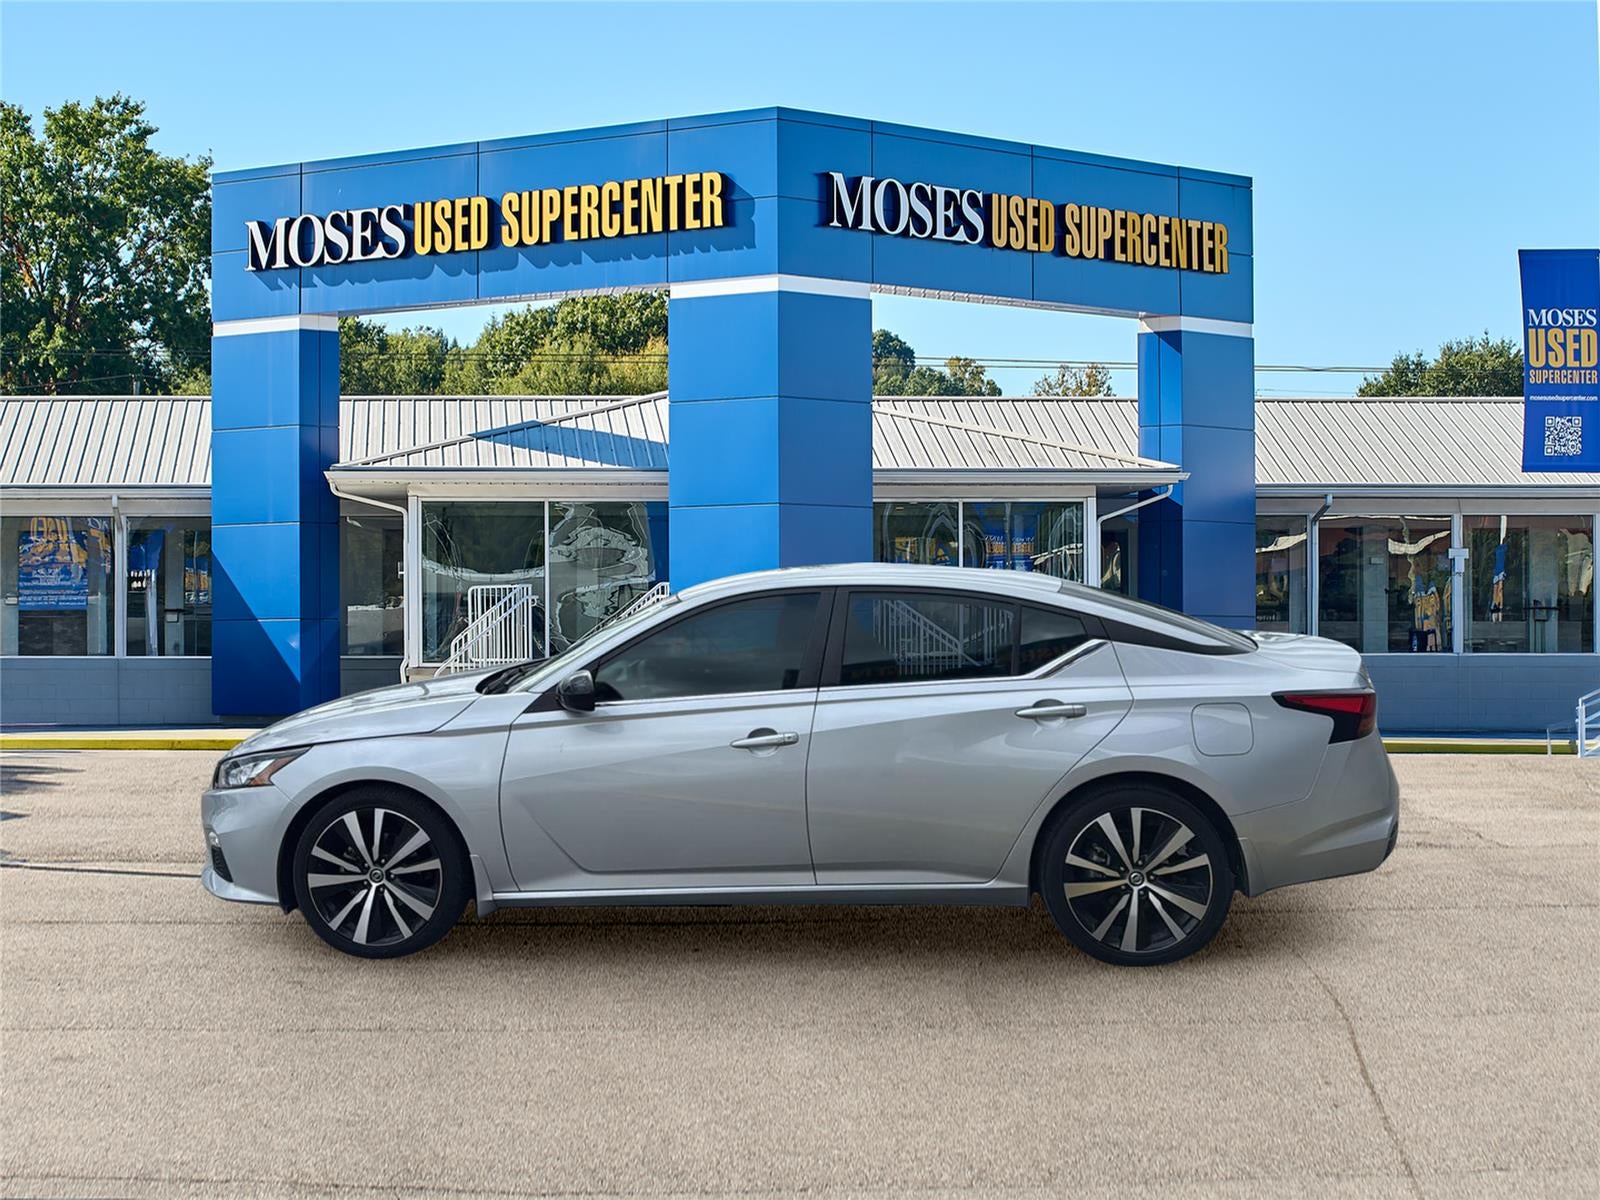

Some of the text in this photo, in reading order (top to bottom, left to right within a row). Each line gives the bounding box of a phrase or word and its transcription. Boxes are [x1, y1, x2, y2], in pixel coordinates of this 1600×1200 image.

[244, 171, 724, 272] MOSES USED SUPERCENTER
[828, 171, 1230, 274] MOSES USED SUPERCENTER
[1527, 308, 1598, 327] MOSES
[1528, 328, 1599, 368] USED
[1529, 369, 1599, 384] SUPERCENTER
